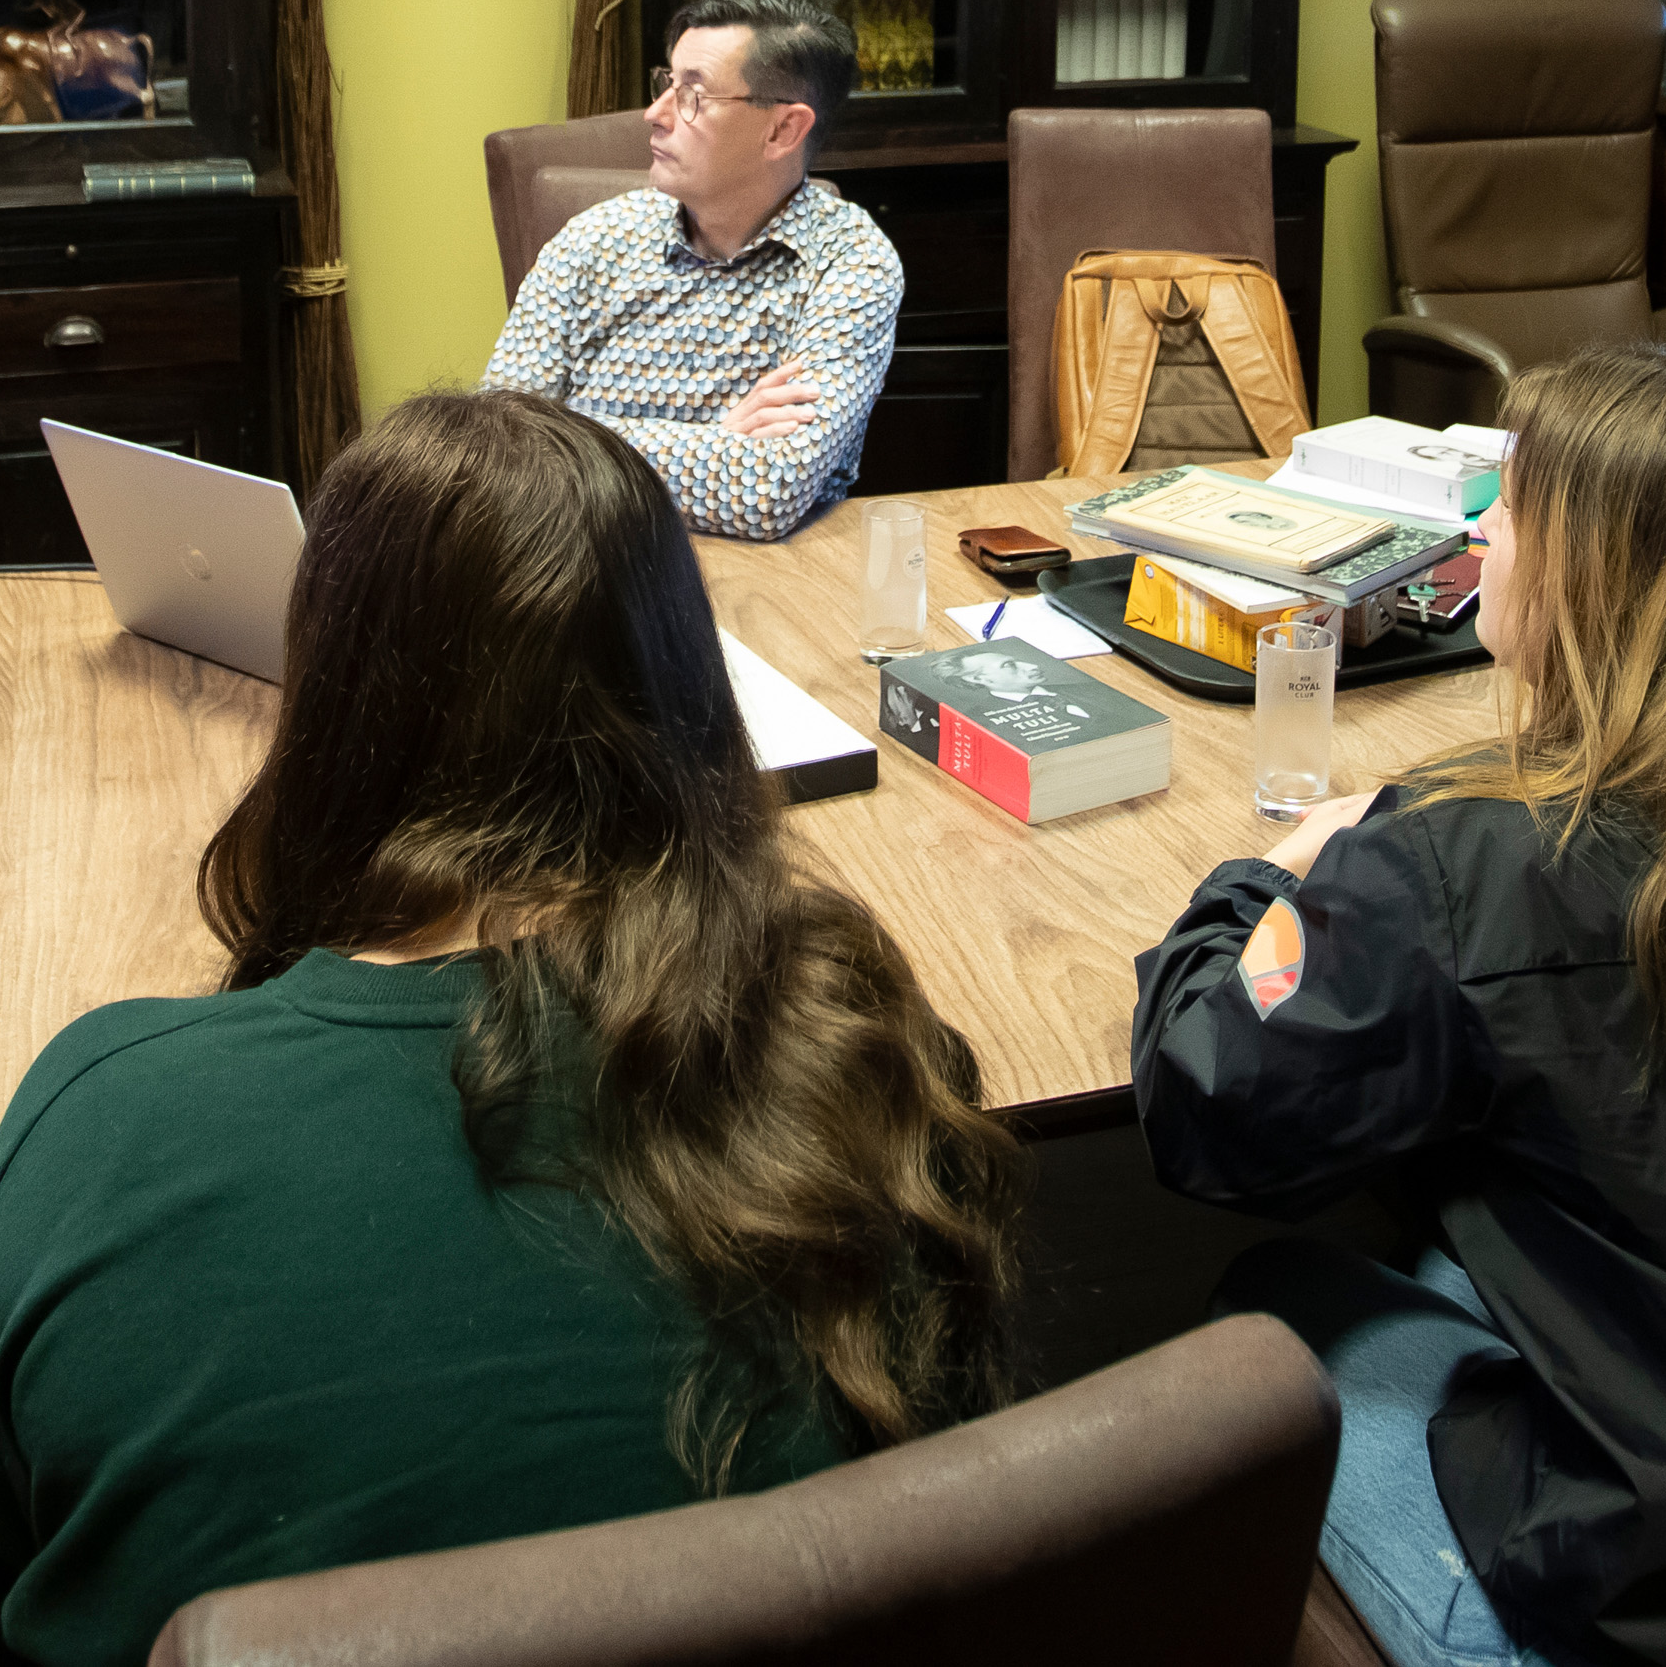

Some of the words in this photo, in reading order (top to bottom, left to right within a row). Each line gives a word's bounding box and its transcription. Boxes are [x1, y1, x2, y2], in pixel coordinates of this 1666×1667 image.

[1288, 682, 1321, 692] ROYAL
[989, 705, 1055, 725] MULTA
[1013, 715, 1059, 730] TULI
[963, 734, 971, 769] TULI
